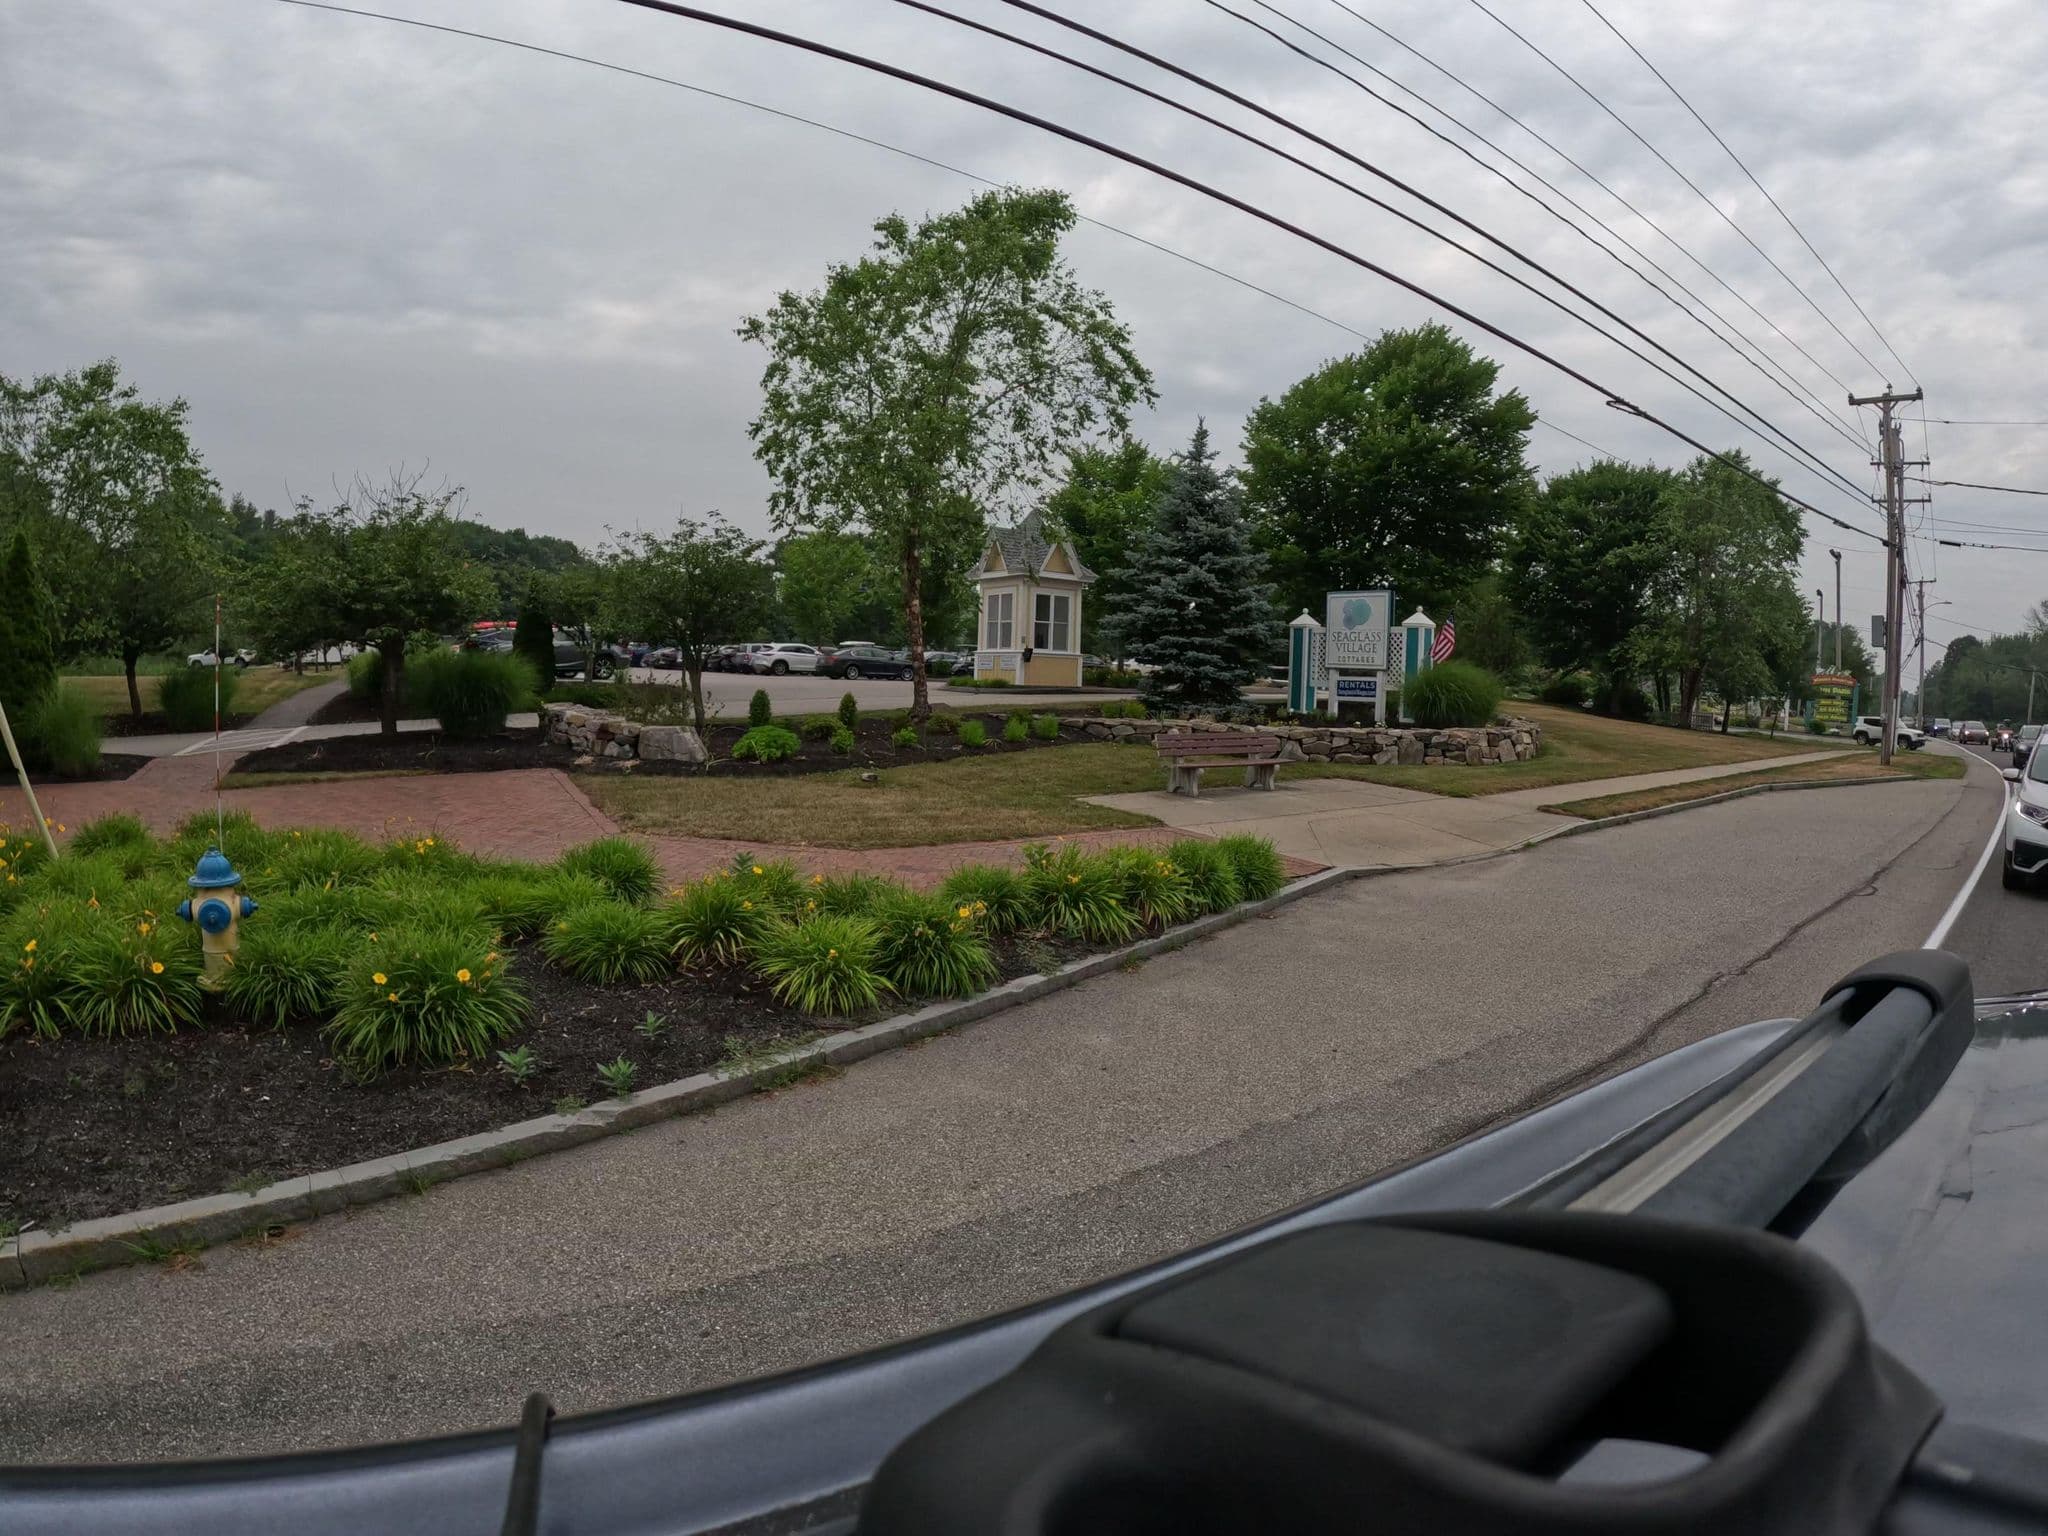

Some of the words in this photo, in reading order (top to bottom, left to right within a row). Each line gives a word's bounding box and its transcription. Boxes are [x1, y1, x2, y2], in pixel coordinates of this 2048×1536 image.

[1332, 631, 1382, 642] SEAGLASS
[1336, 642, 1377, 653] VILLAGE
[1338, 655, 1375, 663] COTTAGES
[1339, 681, 1376, 689] RENTALS
